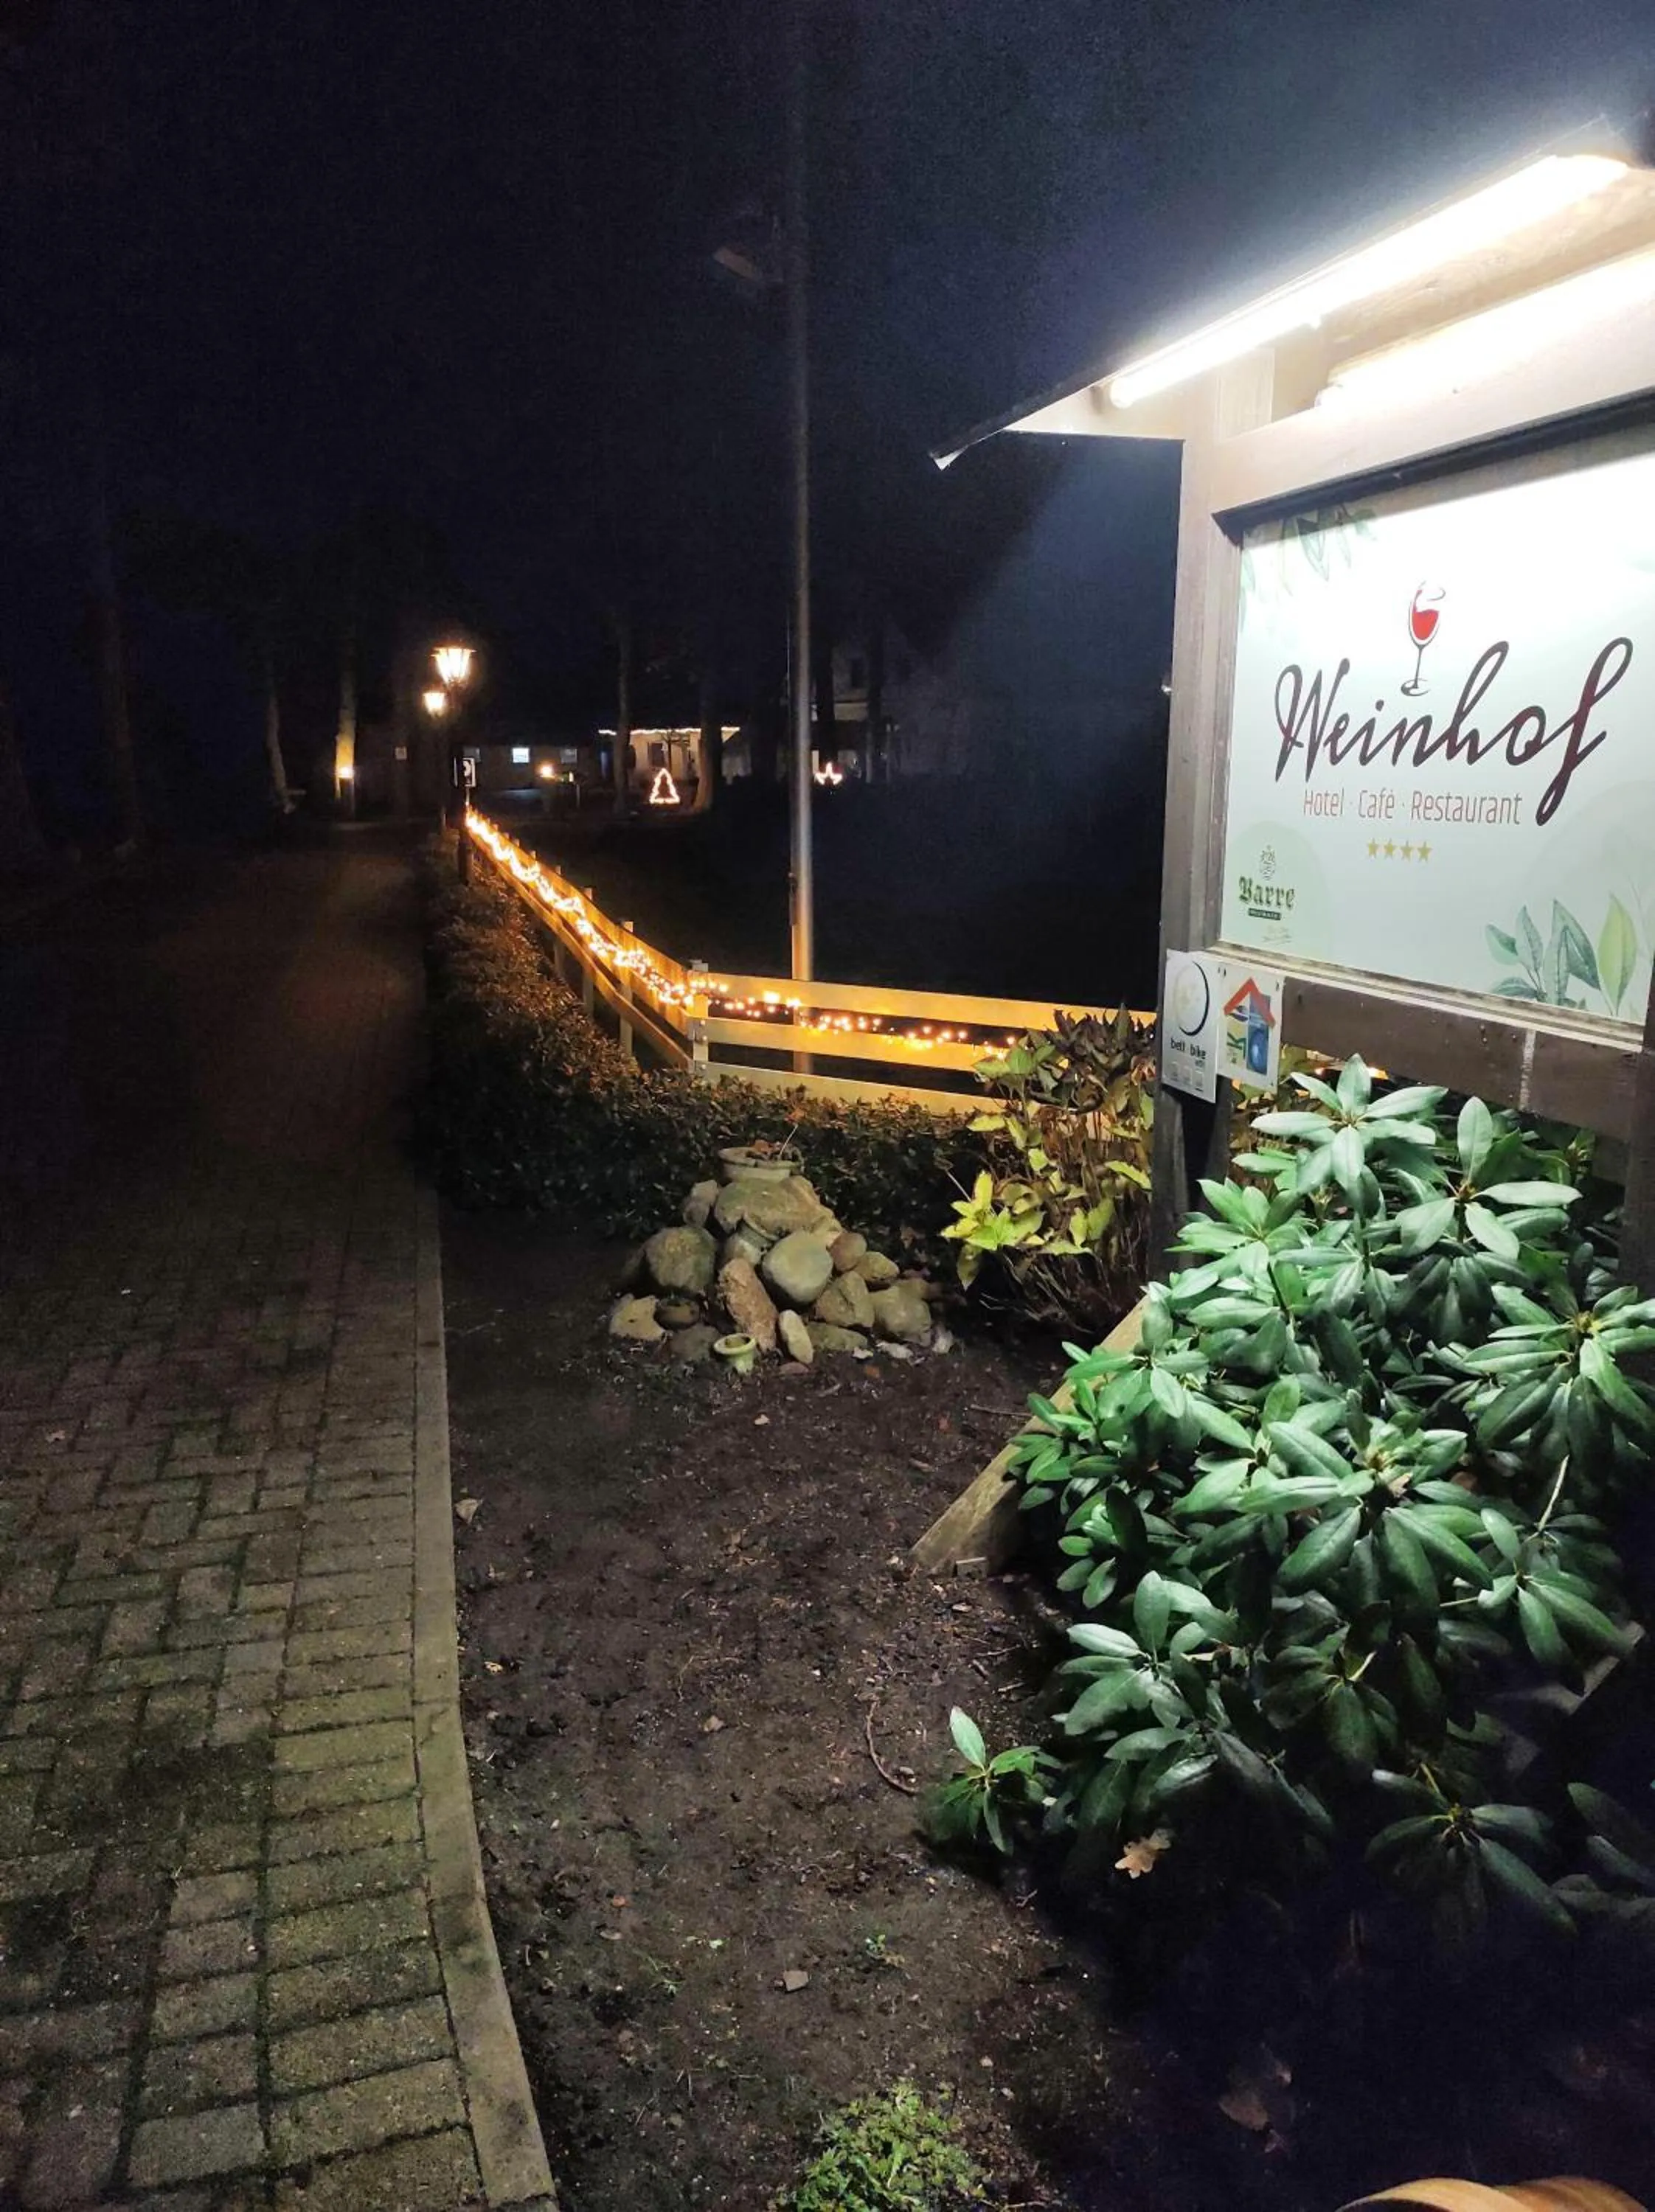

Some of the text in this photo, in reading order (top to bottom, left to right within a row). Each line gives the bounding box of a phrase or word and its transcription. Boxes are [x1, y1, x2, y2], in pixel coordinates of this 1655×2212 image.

[1274, 637, 1633, 826] Weinhof
[1303, 787, 1523, 825] Hotel Café Restaurant
[1239, 875, 1296, 911] Barre
